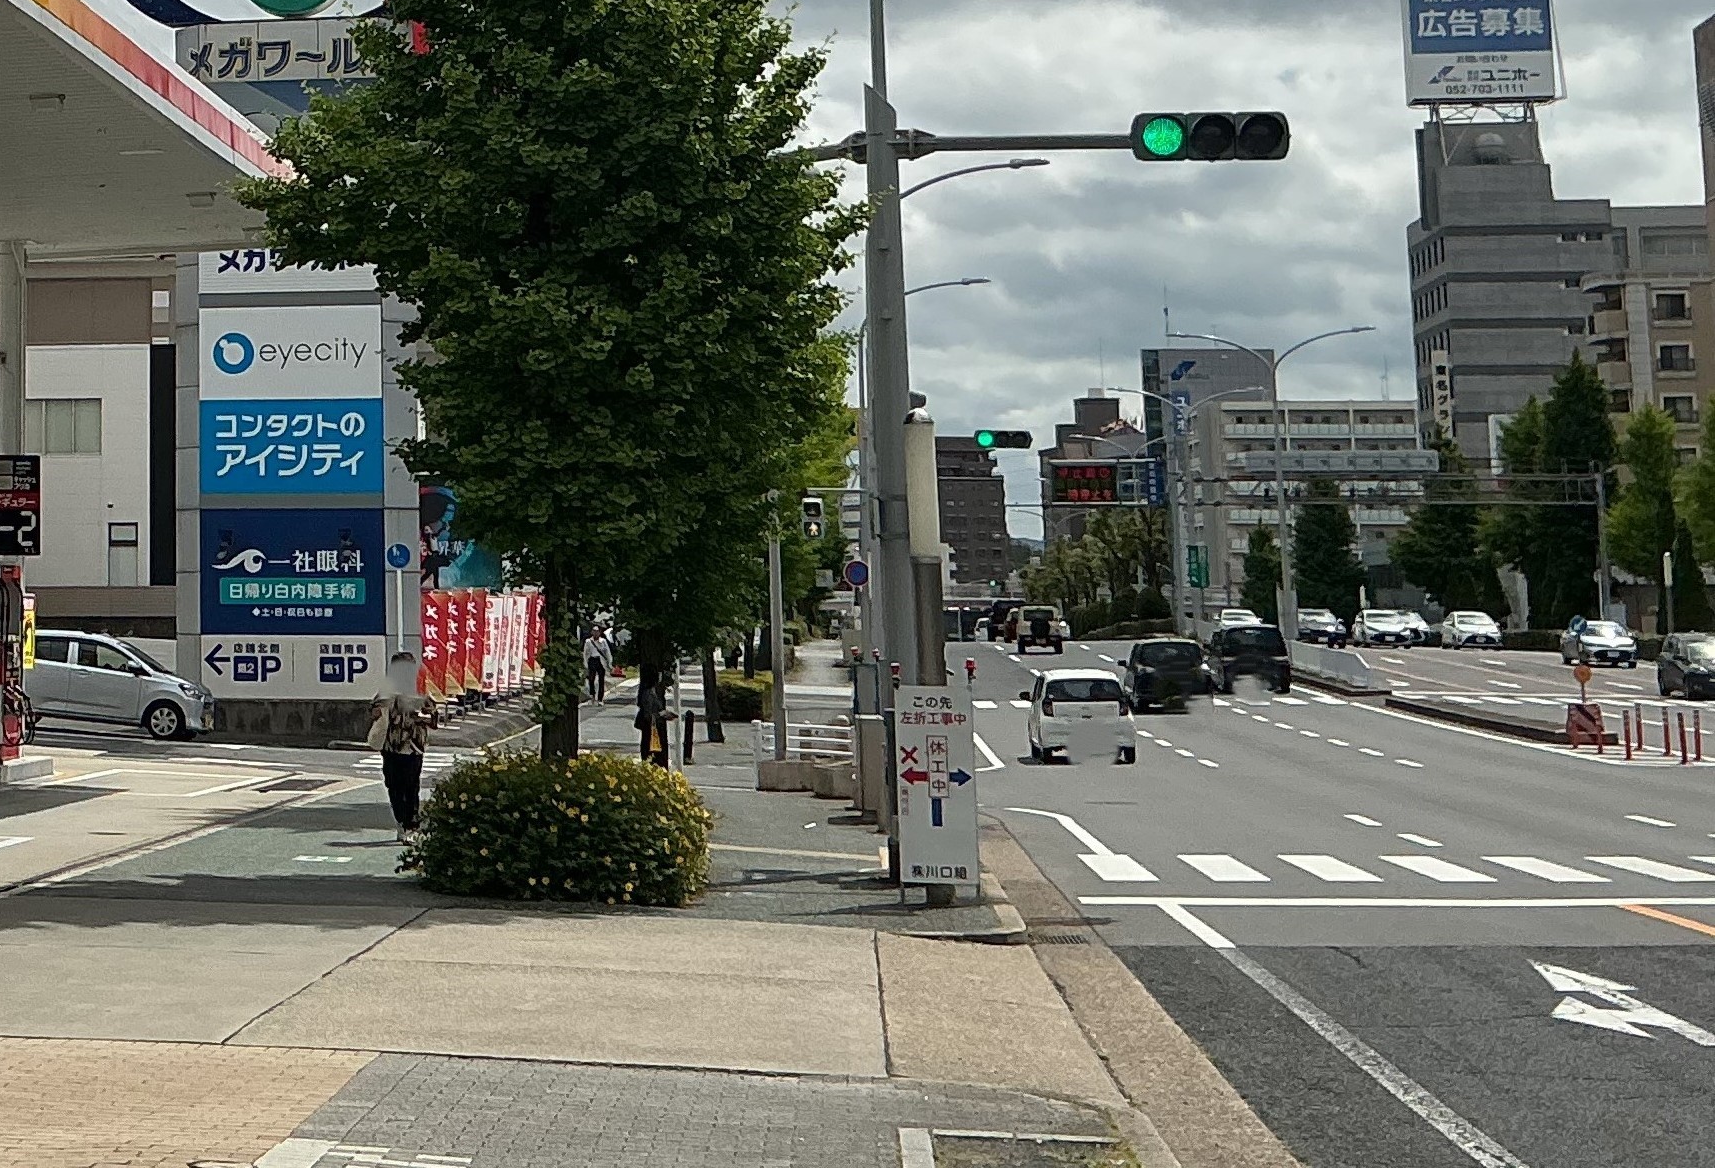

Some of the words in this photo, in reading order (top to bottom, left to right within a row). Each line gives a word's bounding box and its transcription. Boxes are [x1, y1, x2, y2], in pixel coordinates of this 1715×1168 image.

[1417, 7, 1545, 38] 広告募集
[258, 338, 368, 369] eyecity
[215, 412, 366, 439] コンタクトの
[215, 443, 365, 478] アイシティ
[267, 549, 365, 573] 一社眼科
[229, 583, 357, 600] 日帰り白内障手術
[261, 656, 281, 682] P
[348, 656, 368, 682] P
[913, 696, 953, 709] この先
[900, 712, 967, 725] 左折工事中
[929, 740, 947, 793] 休工中
